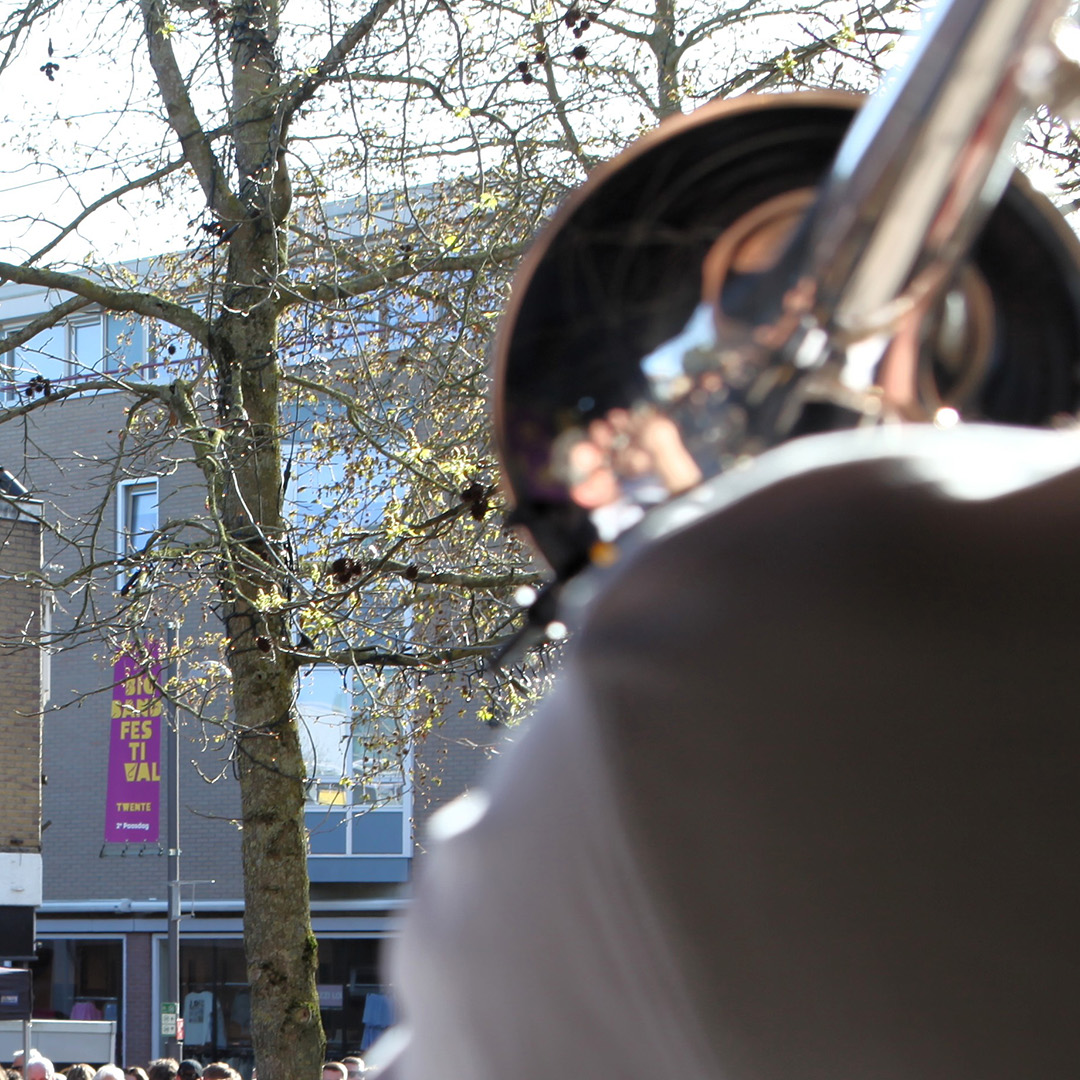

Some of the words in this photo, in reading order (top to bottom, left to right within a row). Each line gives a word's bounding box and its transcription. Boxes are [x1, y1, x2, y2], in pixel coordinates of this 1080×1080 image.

[120, 720, 152, 740] FES
[129, 742, 146, 761] TI
[124, 762, 160, 782] VAL
[116, 802, 151, 812] TWENTE
